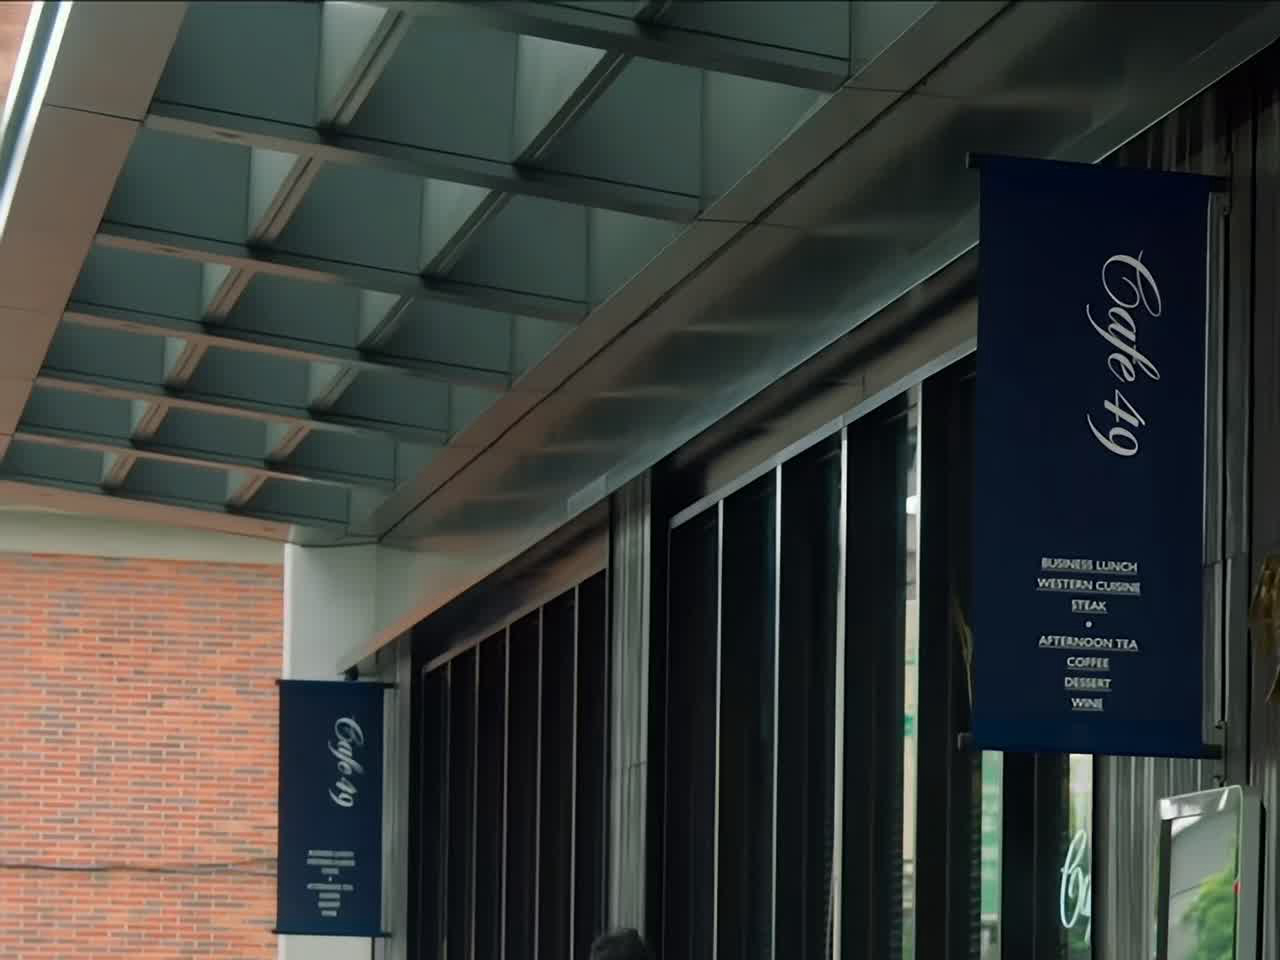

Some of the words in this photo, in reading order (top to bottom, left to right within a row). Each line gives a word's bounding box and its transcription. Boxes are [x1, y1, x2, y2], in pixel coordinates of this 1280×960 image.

[1086, 249, 1162, 383] Cafe
[1086, 389, 1146, 457] 49
[1041, 557, 1093, 572] BUSINESS
[1096, 560, 1138, 574] LUNCH
[1037, 578, 1093, 591] WESTERN
[1095, 581, 1141, 595] CUISINE
[1071, 599, 1107, 612] STEAK
[1038, 635, 1112, 649] AFTERNOON
[1116, 638, 1138, 651] TEA
[1067, 656, 1109, 670] COFFEE
[1064, 676, 1112, 690] DESSERT
[1071, 697, 1103, 711] WINE
[327, 715, 365, 775] Cafe
[328, 777, 358, 808] 49
